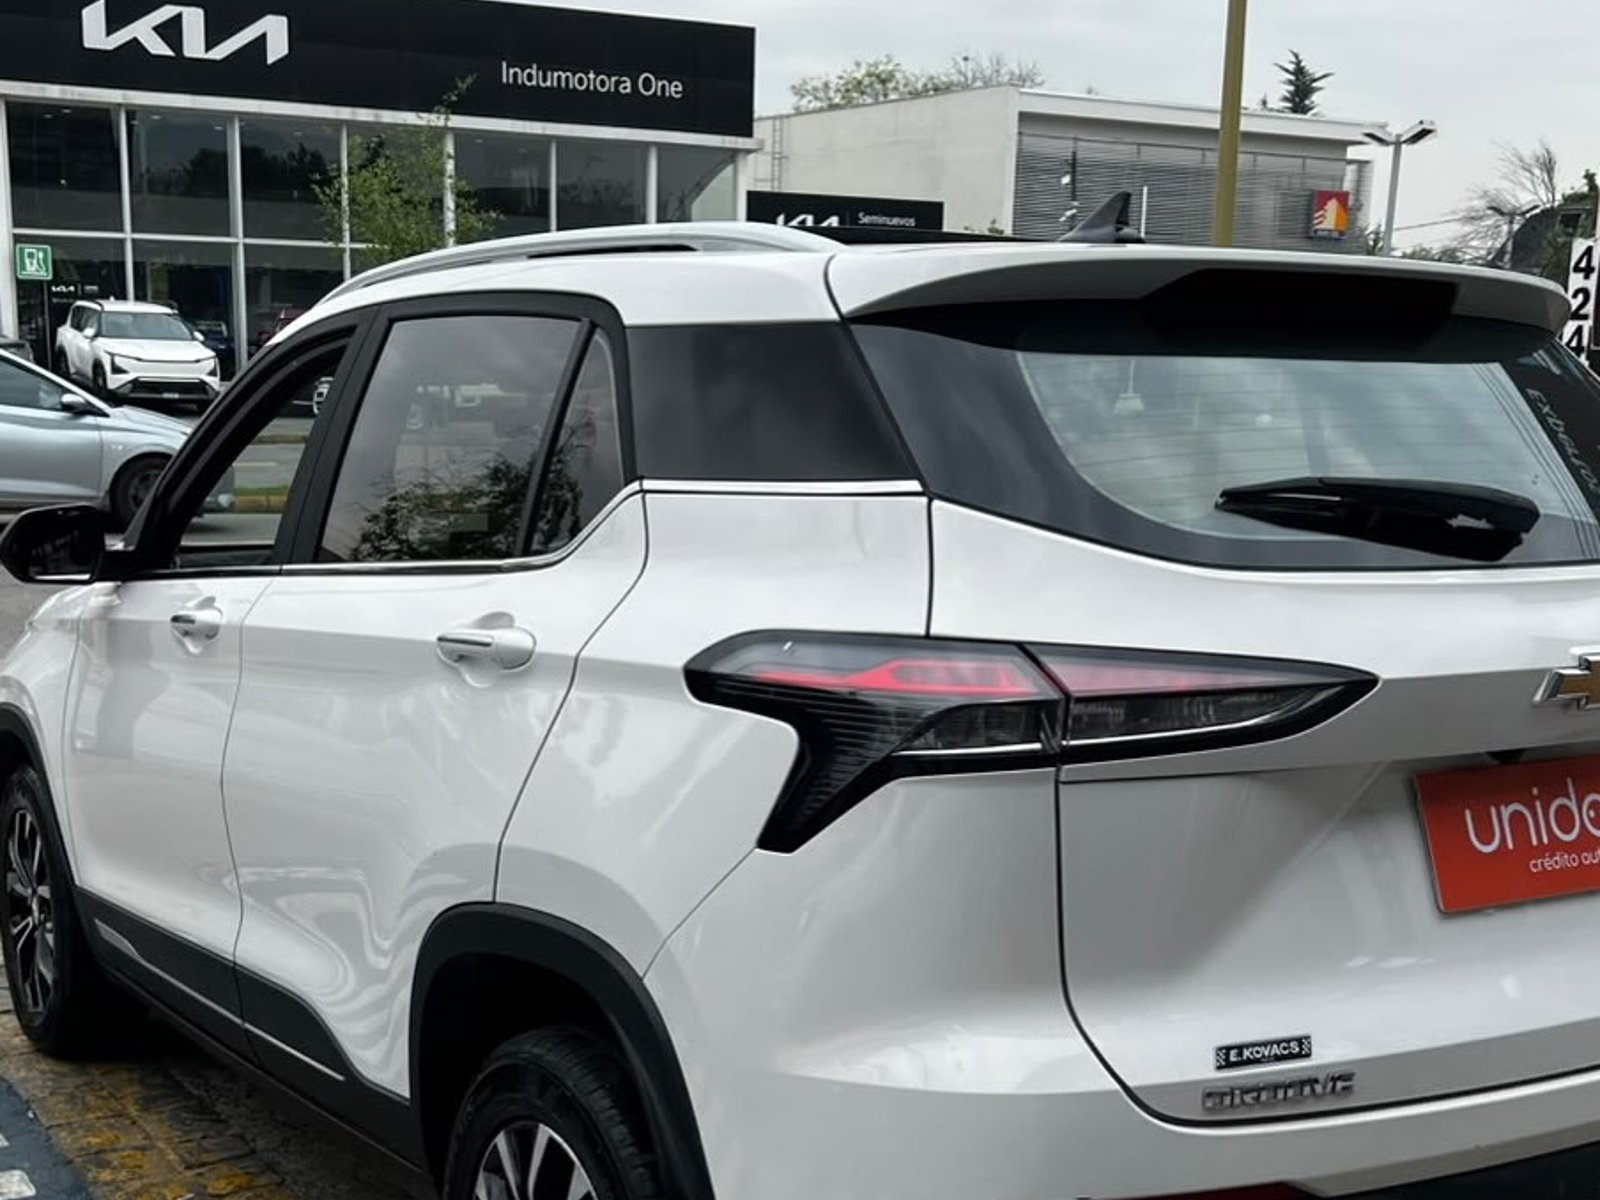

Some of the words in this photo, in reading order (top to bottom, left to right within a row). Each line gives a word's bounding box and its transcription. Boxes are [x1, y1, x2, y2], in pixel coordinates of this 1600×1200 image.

[81, 0, 289, 65] KIA
[501, 60, 632, 94] Indumotora
[637, 72, 683, 98] One
[857, 211, 917, 227] Seminuevos
[1529, 853, 1578, 873] crédito
[1228, 1040, 1300, 1062] E.KOVACS
